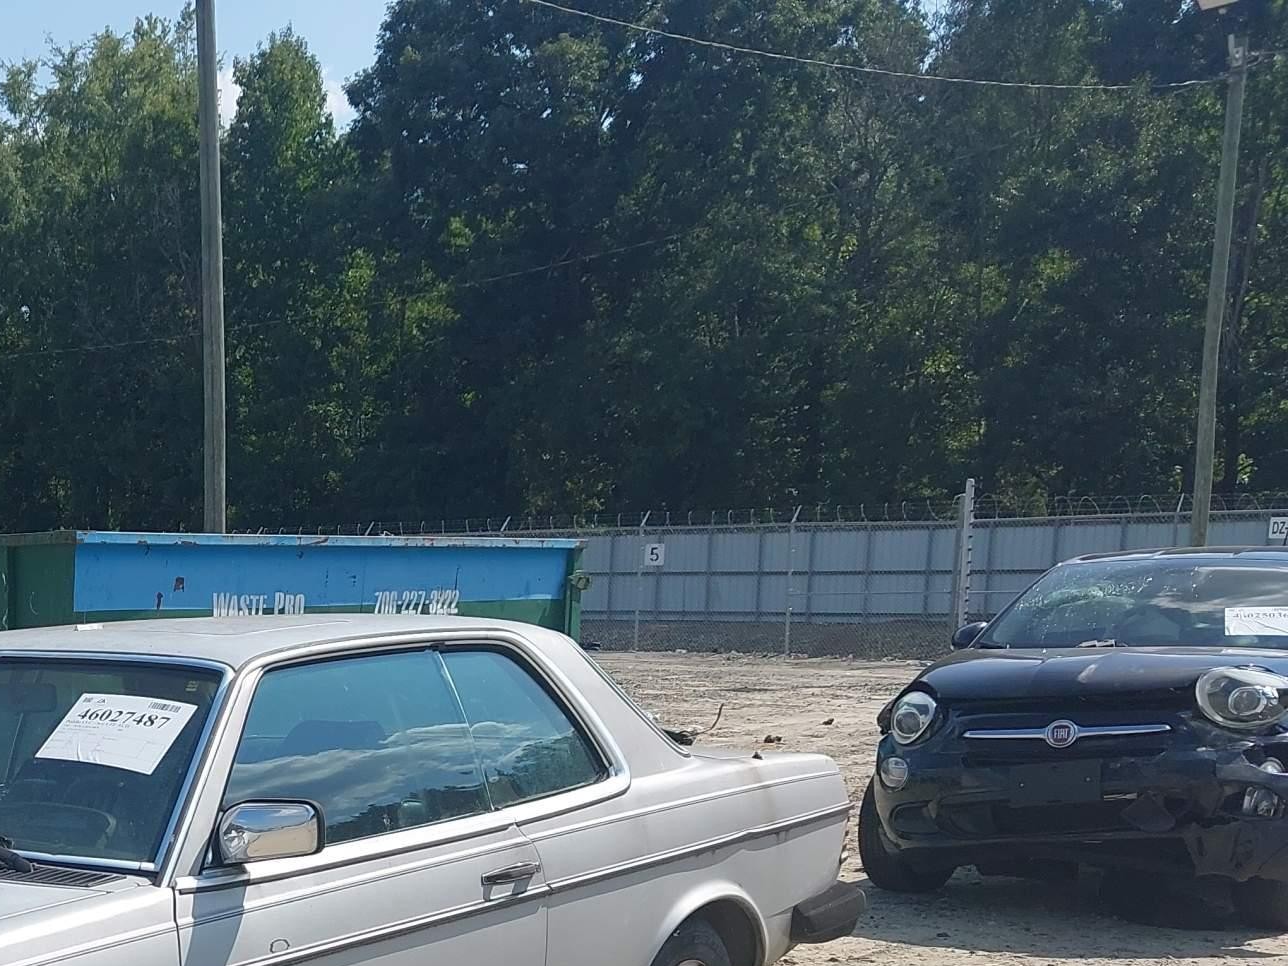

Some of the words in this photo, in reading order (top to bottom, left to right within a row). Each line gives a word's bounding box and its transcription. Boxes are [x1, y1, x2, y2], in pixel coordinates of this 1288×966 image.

[649, 547, 660, 561] 5
[212, 591, 268, 617] WASTE
[274, 591, 305, 617] PRO
[77, 708, 171, 729] 46027487
[1053, 727, 1070, 739] FIAT
